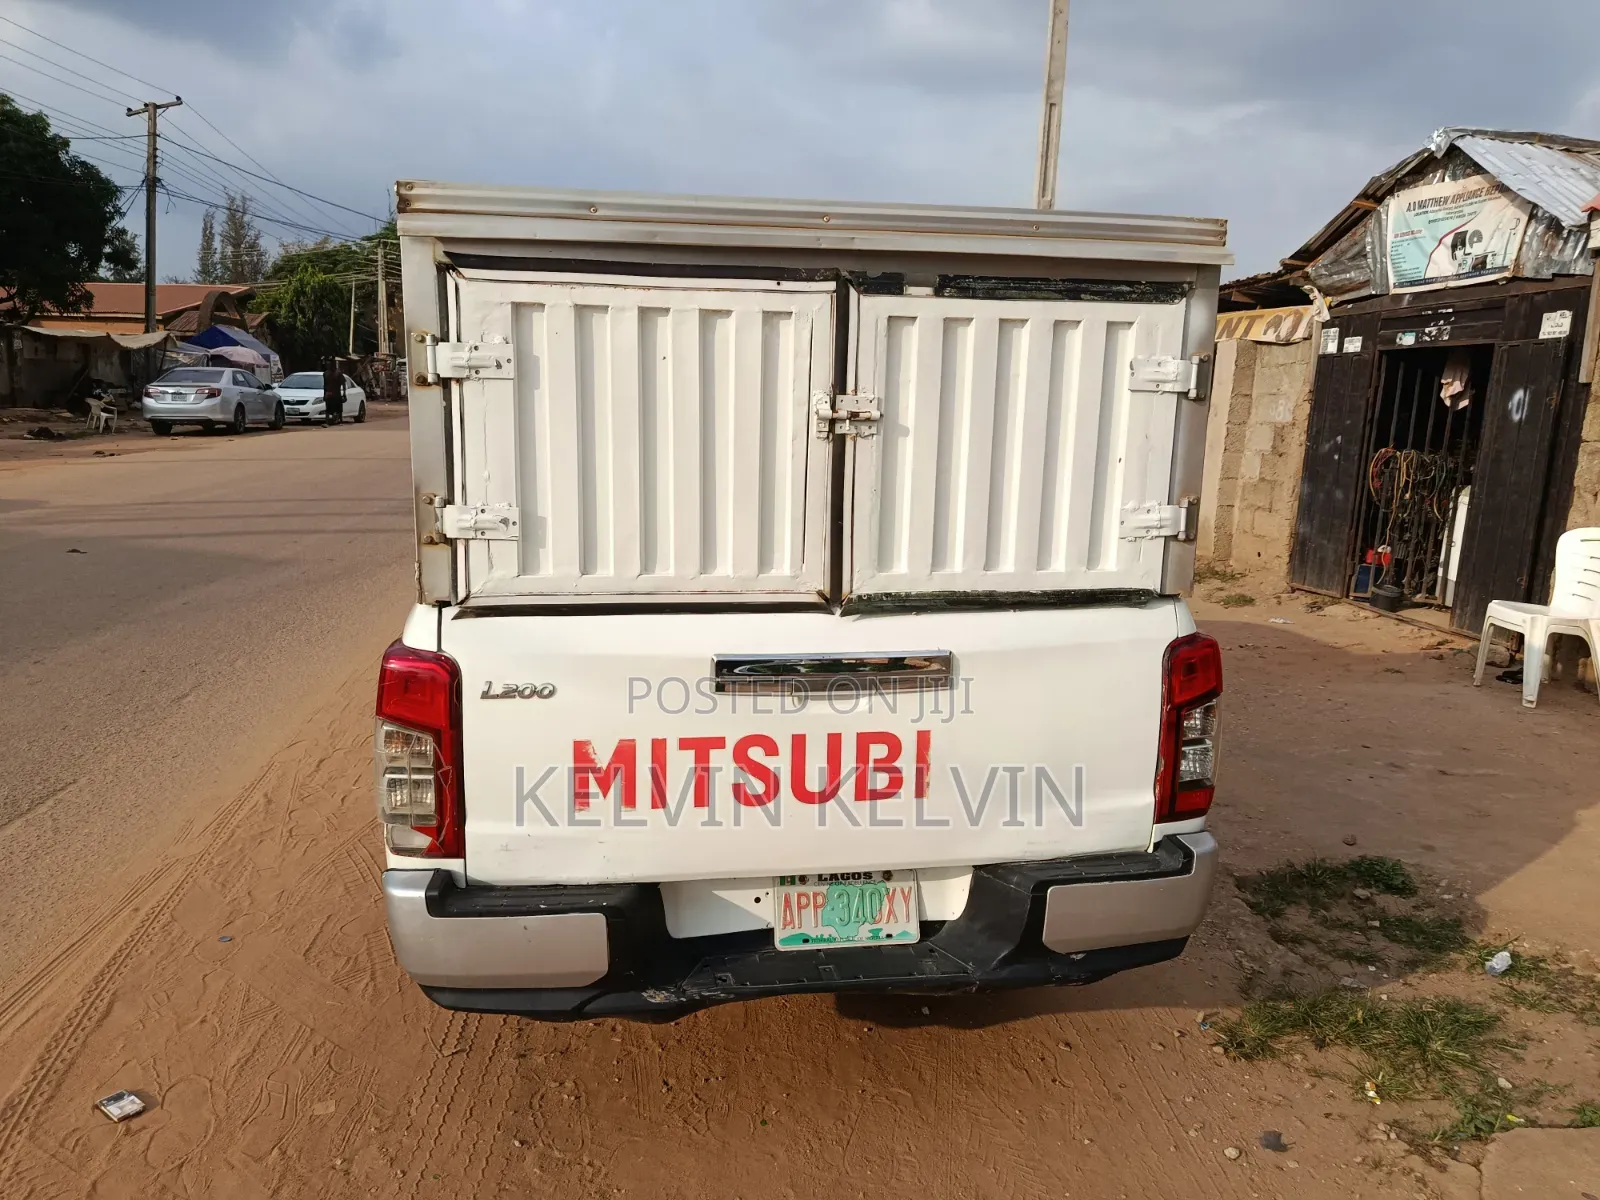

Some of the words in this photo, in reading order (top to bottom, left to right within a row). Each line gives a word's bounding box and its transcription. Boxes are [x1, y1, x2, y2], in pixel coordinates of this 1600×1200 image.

[1417, 195, 1451, 210] MATTHEW
[1450, 187, 1485, 205] APPLIANCE
[480, 681, 557, 699] L200
[573, 730, 931, 812] MITSUBI
[817, 871, 874, 882] LAGOS
